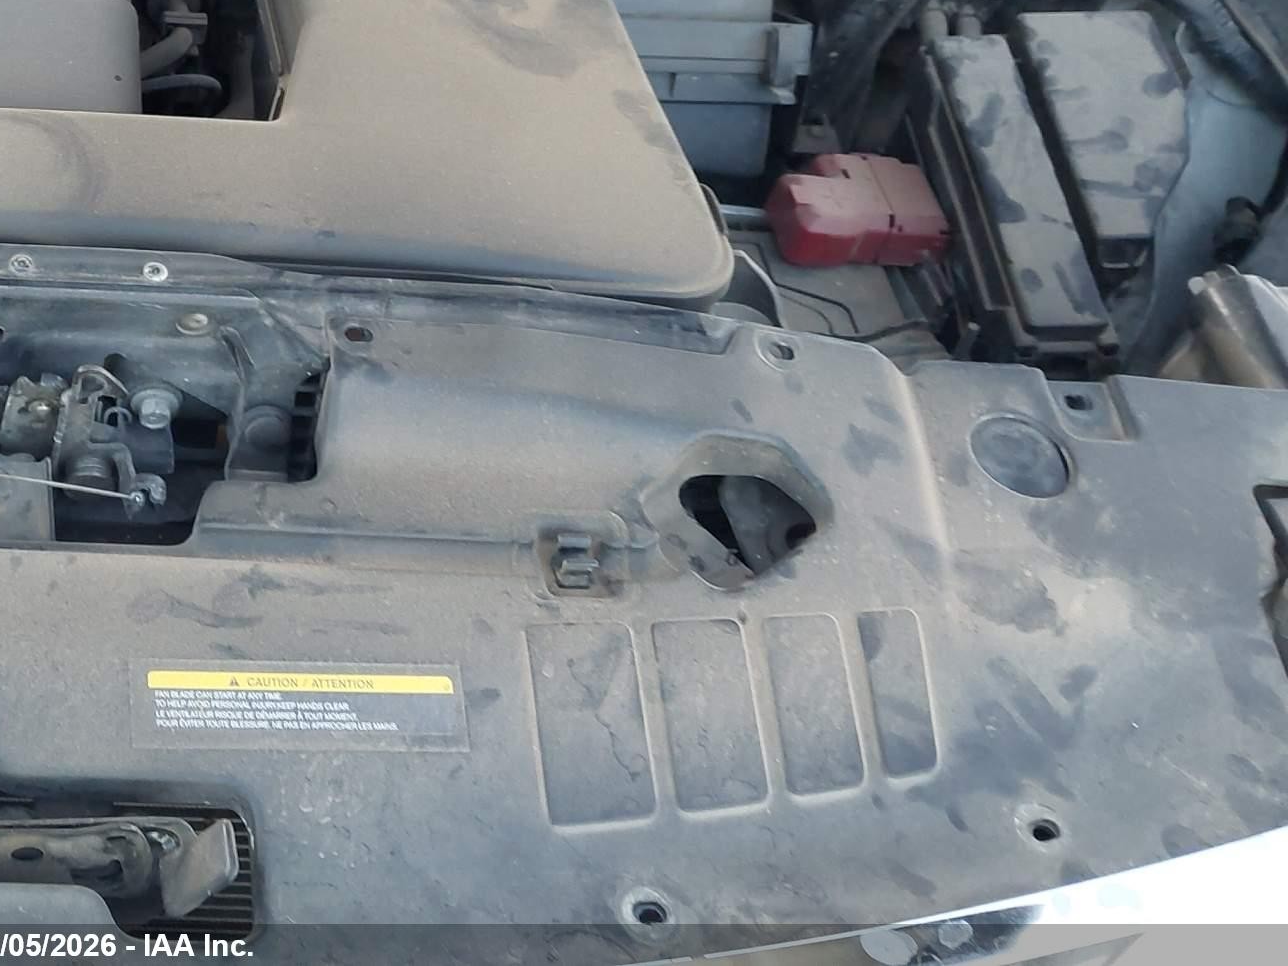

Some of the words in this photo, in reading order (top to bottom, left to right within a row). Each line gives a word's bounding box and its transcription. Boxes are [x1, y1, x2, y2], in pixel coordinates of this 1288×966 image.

[246, 677, 299, 688] CAUTION
[311, 678, 375, 690] ATTENTION
[155, 698, 167, 708] TO
